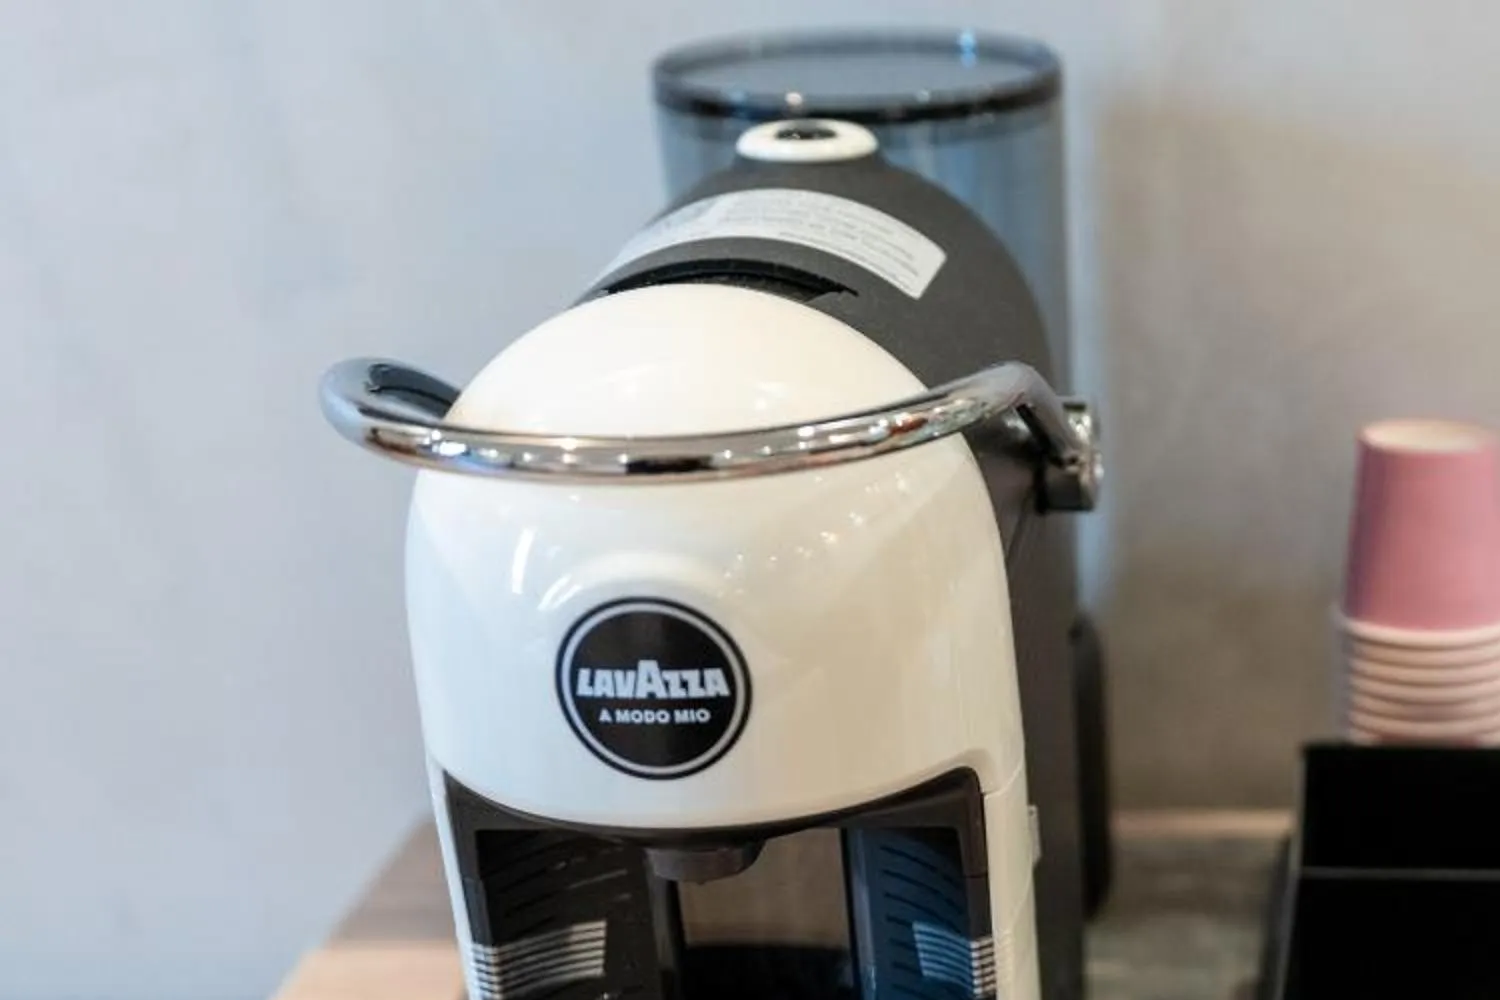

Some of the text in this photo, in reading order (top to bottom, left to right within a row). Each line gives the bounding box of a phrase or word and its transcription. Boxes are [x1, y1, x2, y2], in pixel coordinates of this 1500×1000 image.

[576, 660, 731, 699] LAVAZZA
[599, 708, 711, 724] A MODO MIO
